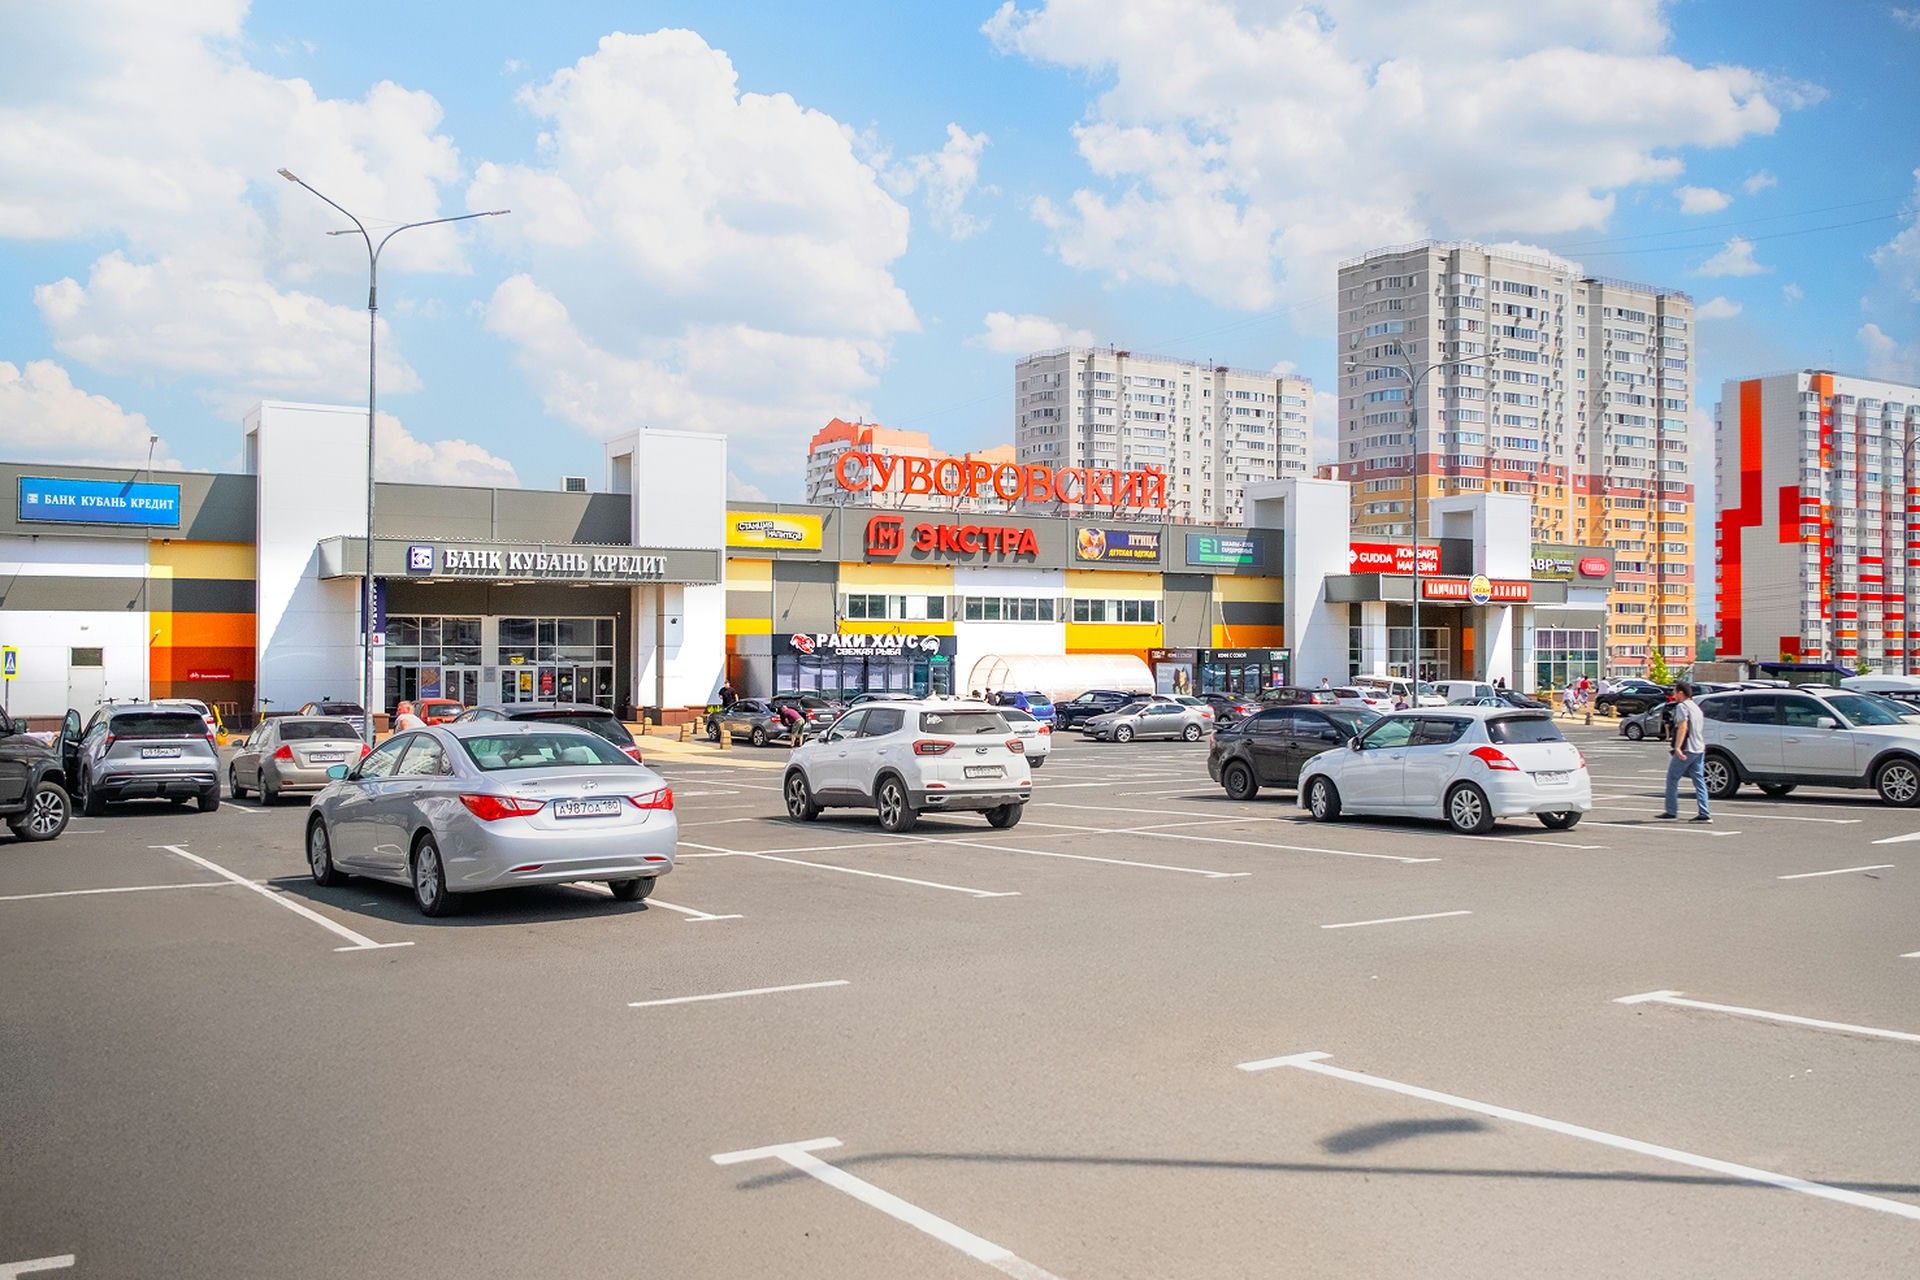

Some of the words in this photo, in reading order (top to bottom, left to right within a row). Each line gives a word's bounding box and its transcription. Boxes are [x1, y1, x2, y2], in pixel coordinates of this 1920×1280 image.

[835, 451, 1168, 509] СУВОРОВСКИЙ
[44, 494, 76, 505] БАНК
[81, 496, 127, 508] КУБАНЬ
[131, 498, 175, 510] КРЕДИТ
[915, 523, 1040, 555] ЭКСТРА
[1128, 534, 1158, 549] ПТИЦА
[1359, 552, 1393, 564] GUDDA
[1395, 548, 1439, 561] ЛОМБАРД
[445, 549, 502, 570] БАНК
[508, 552, 589, 572] КУБАНЬ
[593, 554, 667, 575] КРЕДИТ
[1427, 583, 1467, 595] КАМЧАТКА
[816, 634, 866, 648] РАКИ
[870, 635, 919, 648] ХАУС
[835, 648, 874, 656] СВЕЖАЯ
[876, 648, 902, 656] РЫБА
